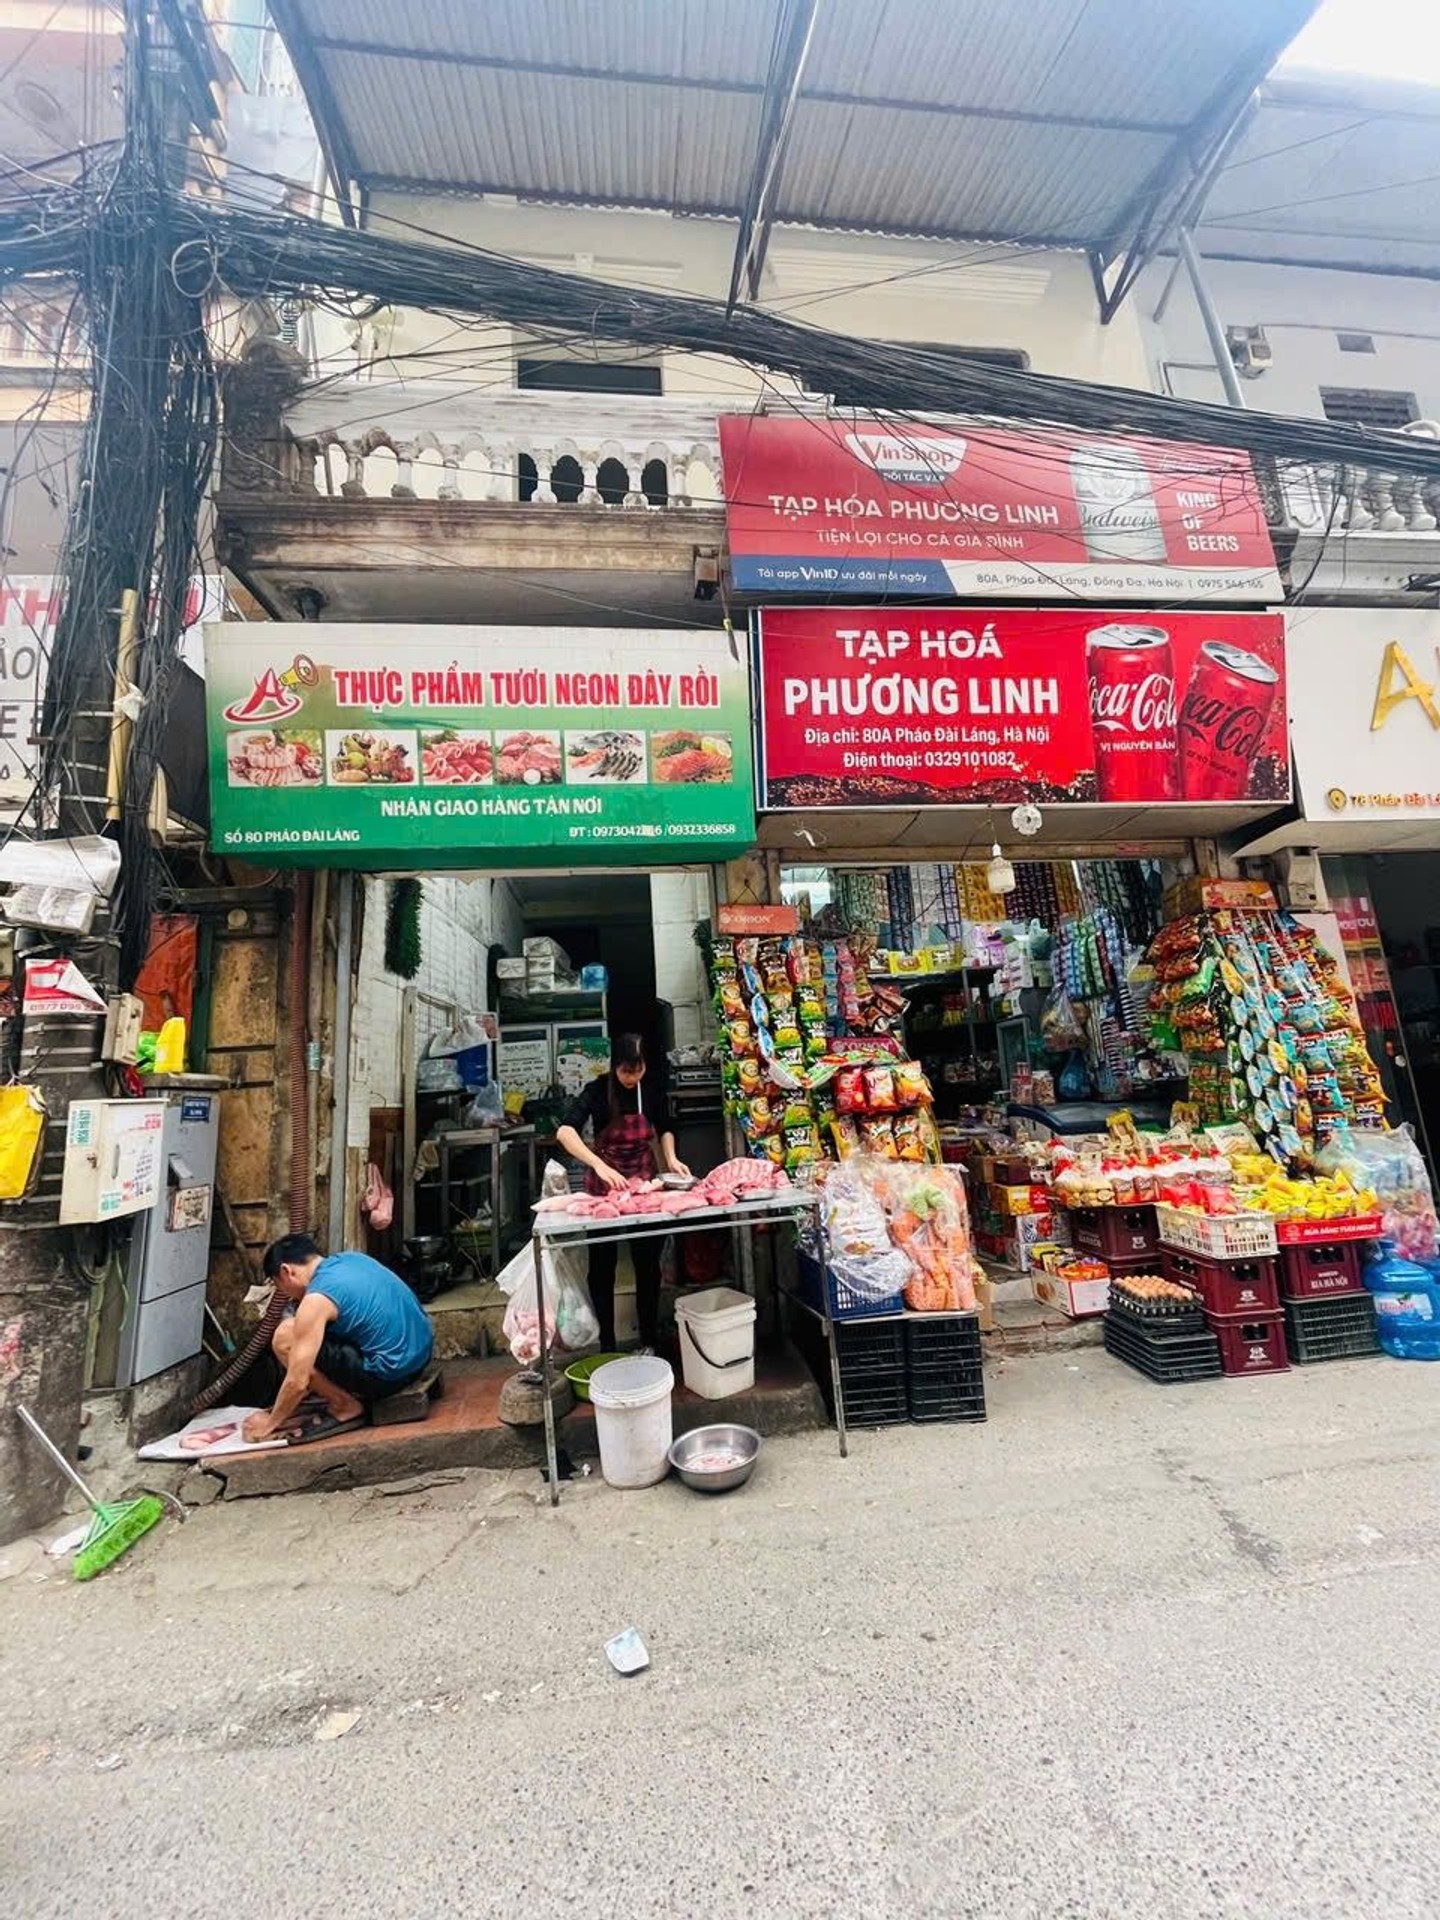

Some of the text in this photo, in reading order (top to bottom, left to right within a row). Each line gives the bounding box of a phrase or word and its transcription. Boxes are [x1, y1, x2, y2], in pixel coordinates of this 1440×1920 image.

[768, 495, 817, 521] TẠP
[824, 493, 883, 517] HÓA
[1004, 504, 1059, 524] LINH
[1176, 492, 1217, 508] KING
[1183, 514, 1204, 530] OF
[816, 528, 851, 545] TIỆN
[886, 532, 922, 546] CHO
[954, 534, 983, 547] GIA
[1186, 535, 1240, 552] BEERS
[777, 571, 799, 580] app
[799, 566, 839, 580] VinID
[835, 623, 1004, 665] TẠP HOÁ
[334, 660, 719, 710] THỰC PHẨM TƯƠI NGON ĐÂY RỒI
[784, 672, 1059, 716] PHƯƠNG LINH
[804, 727, 830, 747] Địa
[862, 728, 895, 743] 80A
[896, 727, 931, 743] Pháo
[934, 727, 959, 743] Đài
[962, 727, 1001, 746] Láng,
[1004, 727, 1023, 743] Hà
[1026, 727, 1050, 746] Nội
[843, 751, 1015, 770] Điện thoại: 0329101082
[381, 795, 603, 819] NHẬN GIAO HÀNG TẬN NƠI
[245, 831, 263, 843] 80
[265, 828, 301, 843] PHÁO
[326, 827, 361, 842] LÁNG
